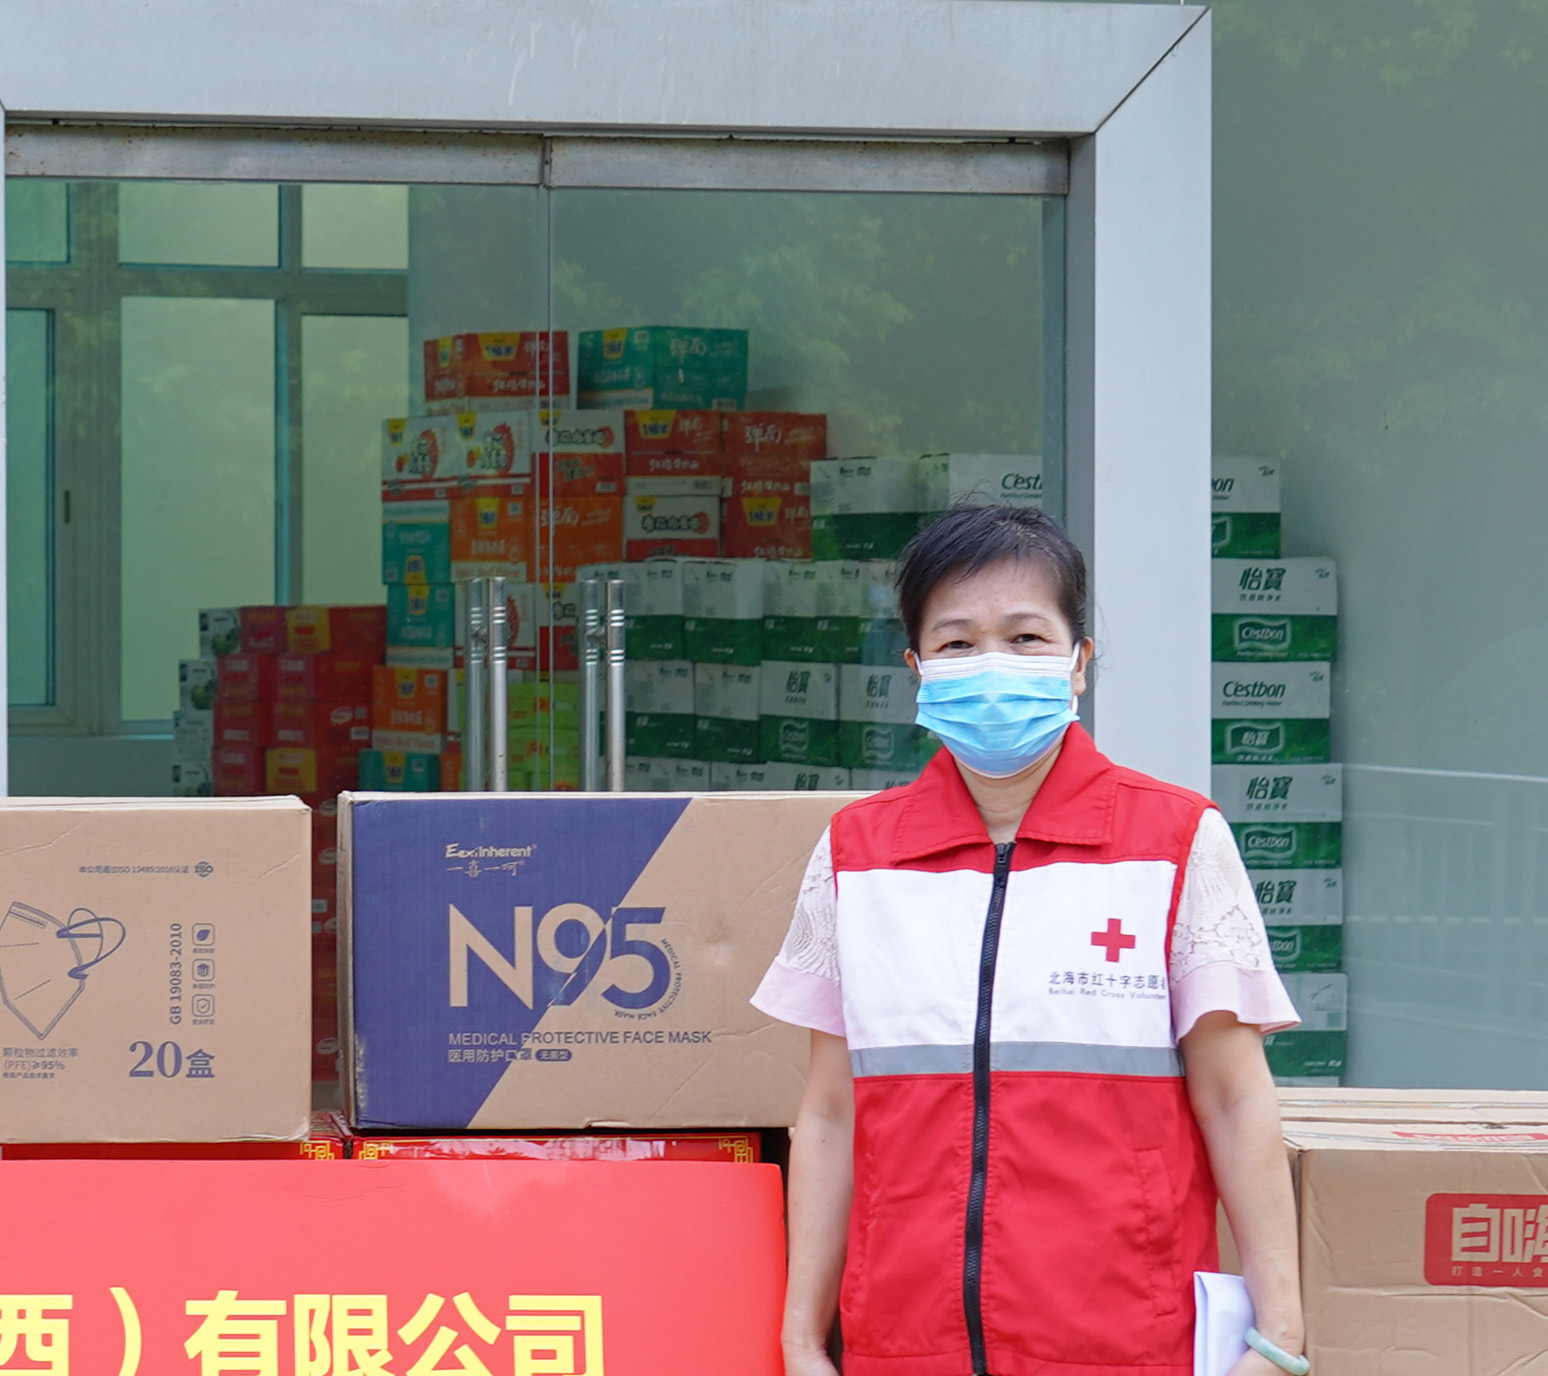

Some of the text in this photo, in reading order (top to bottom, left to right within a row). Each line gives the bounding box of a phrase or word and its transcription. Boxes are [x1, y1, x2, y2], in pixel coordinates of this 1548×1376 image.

[170, 923, 183, 1024] GB 19083-2010
[449, 903, 671, 1010] N95
[129, 1041, 215, 1078] 20盒
[449, 1031, 712, 1045] MEDICAL PROTECTIVE FACE MASK
